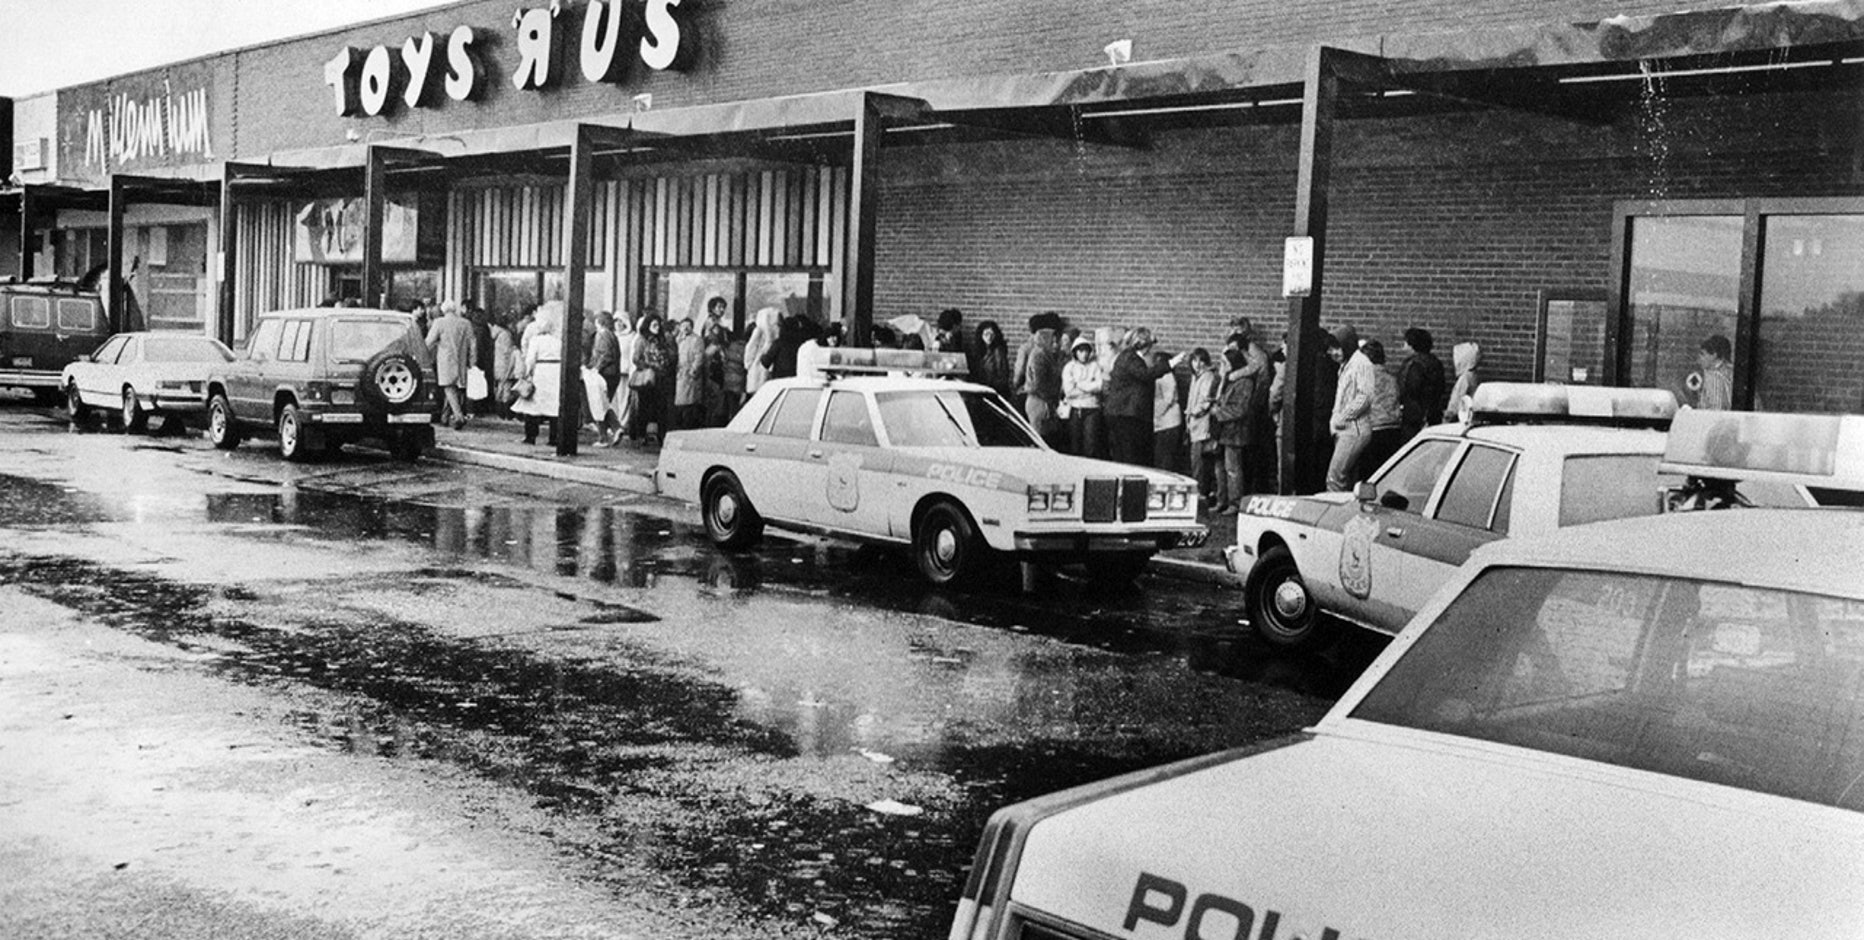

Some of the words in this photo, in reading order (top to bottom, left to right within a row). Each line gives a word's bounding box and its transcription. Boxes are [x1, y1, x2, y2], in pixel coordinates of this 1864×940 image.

[324, 25, 475, 117] TOYS
[580, 0, 681, 82] US
[927, 462, 1003, 490] POLICE
[1246, 496, 1297, 519] POLICE
[1123, 871, 1341, 940] PO
